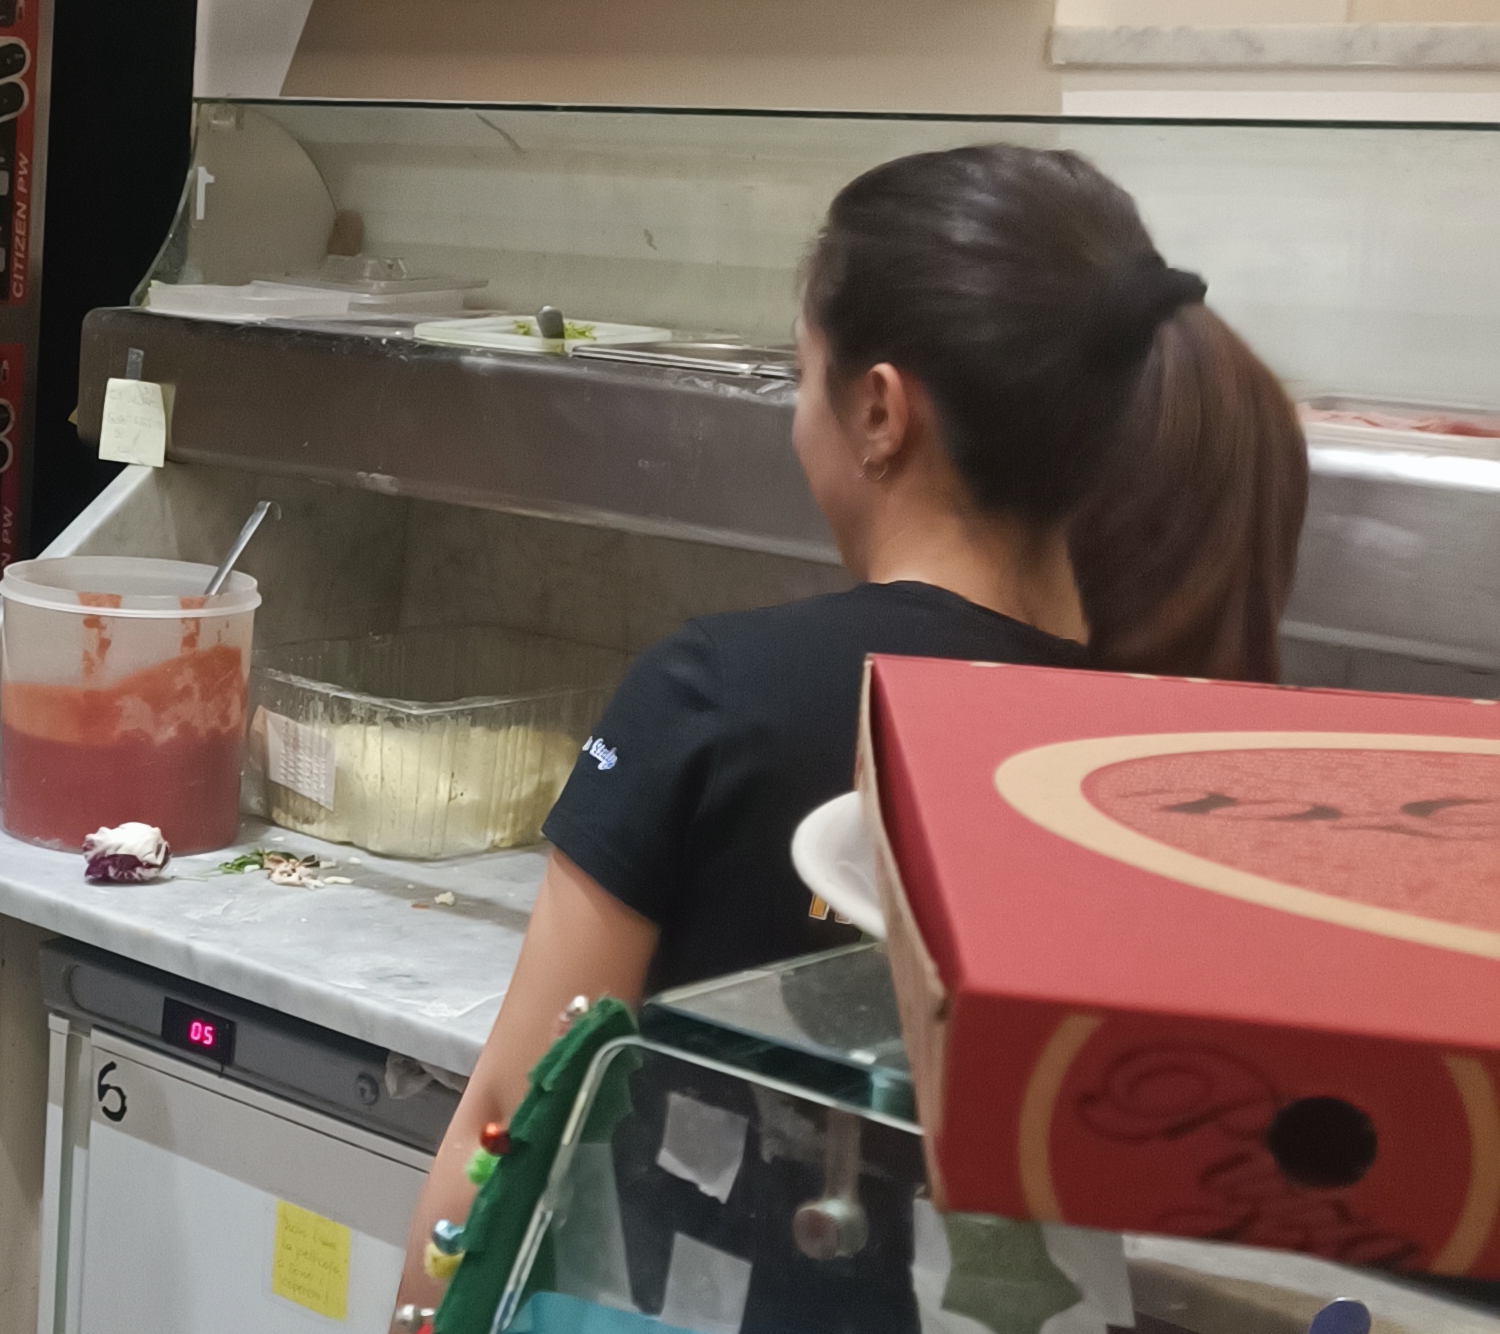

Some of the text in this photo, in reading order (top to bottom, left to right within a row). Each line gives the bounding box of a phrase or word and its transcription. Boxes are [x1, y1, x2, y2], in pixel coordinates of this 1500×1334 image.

[12, 151, 31, 300] CITIZEN PW
[188, 1020, 216, 1046] 05
